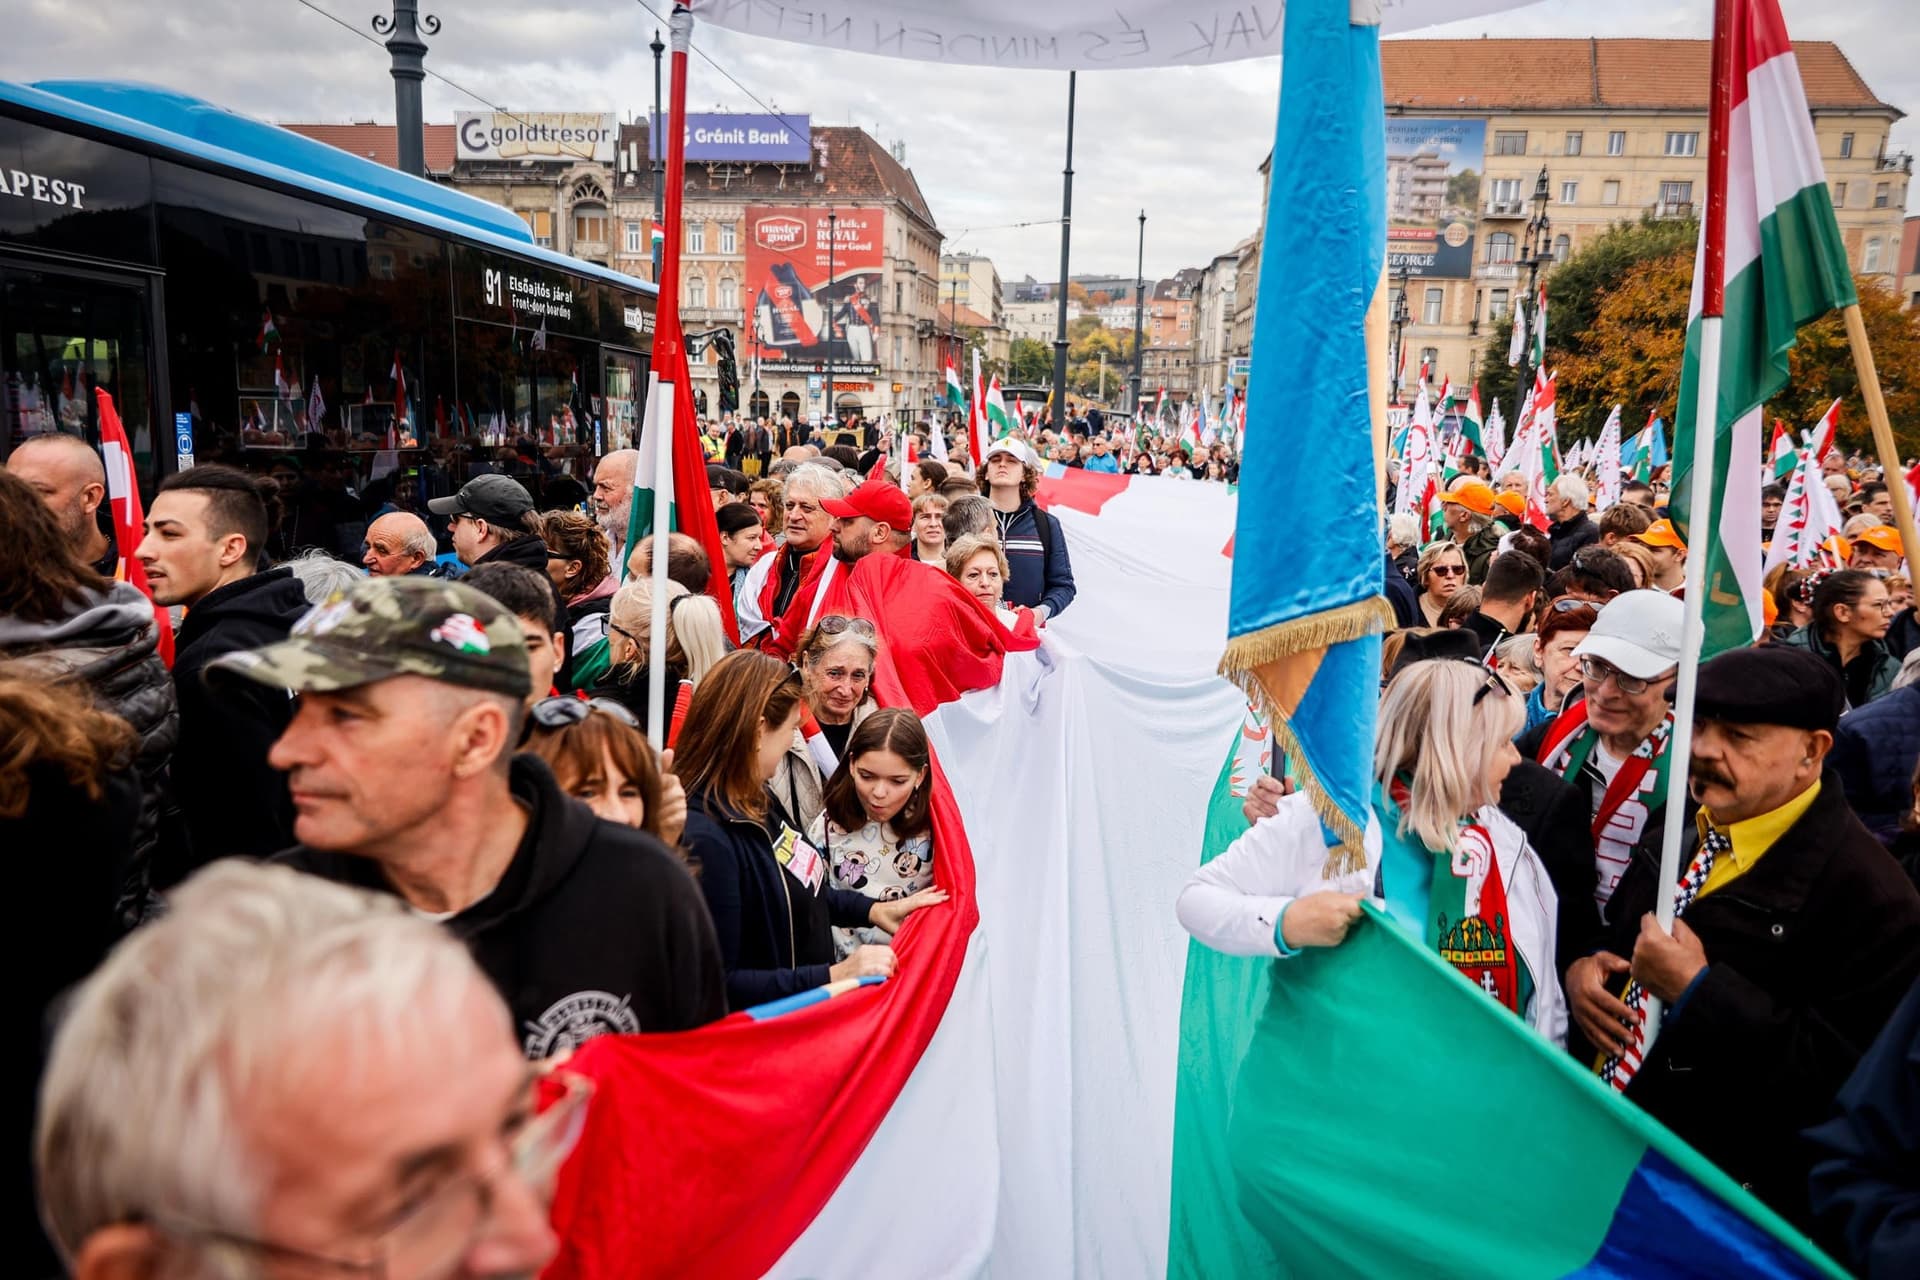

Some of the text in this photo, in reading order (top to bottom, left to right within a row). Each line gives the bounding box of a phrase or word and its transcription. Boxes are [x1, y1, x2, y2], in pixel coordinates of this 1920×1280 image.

[490, 124, 610, 147] goldtresor
[694, 128, 789, 145] Gránit Bank
[761, 222, 802, 234] master
[816, 230, 859, 241] ROYAL
[767, 232, 795, 243] good
[848, 242, 872, 251] Good
[485, 268, 502, 307] 91
[509, 276, 573, 304] Elsőajtós járat
[512, 294, 571, 321] Front-door boarding
